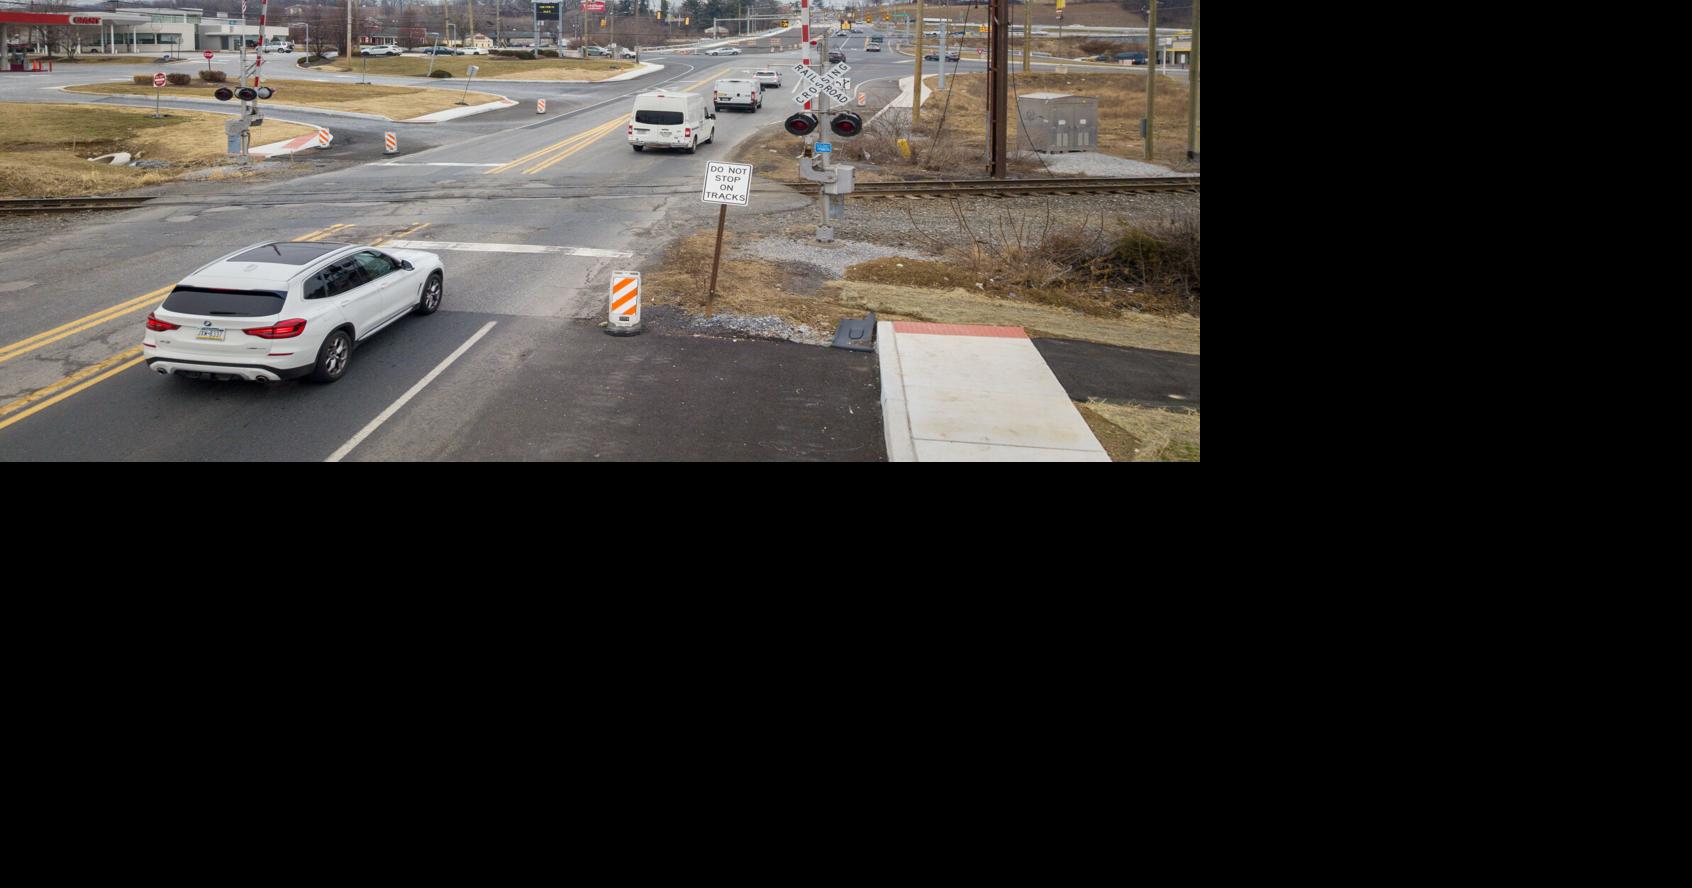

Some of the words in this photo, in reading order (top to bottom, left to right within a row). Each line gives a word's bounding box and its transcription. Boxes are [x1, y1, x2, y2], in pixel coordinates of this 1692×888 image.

[796, 63, 848, 104] CROSSING
[710, 165, 724, 173] DO
[728, 167, 747, 175] NOT
[715, 174, 741, 183] STOP
[706, 191, 746, 202] TRACKS
